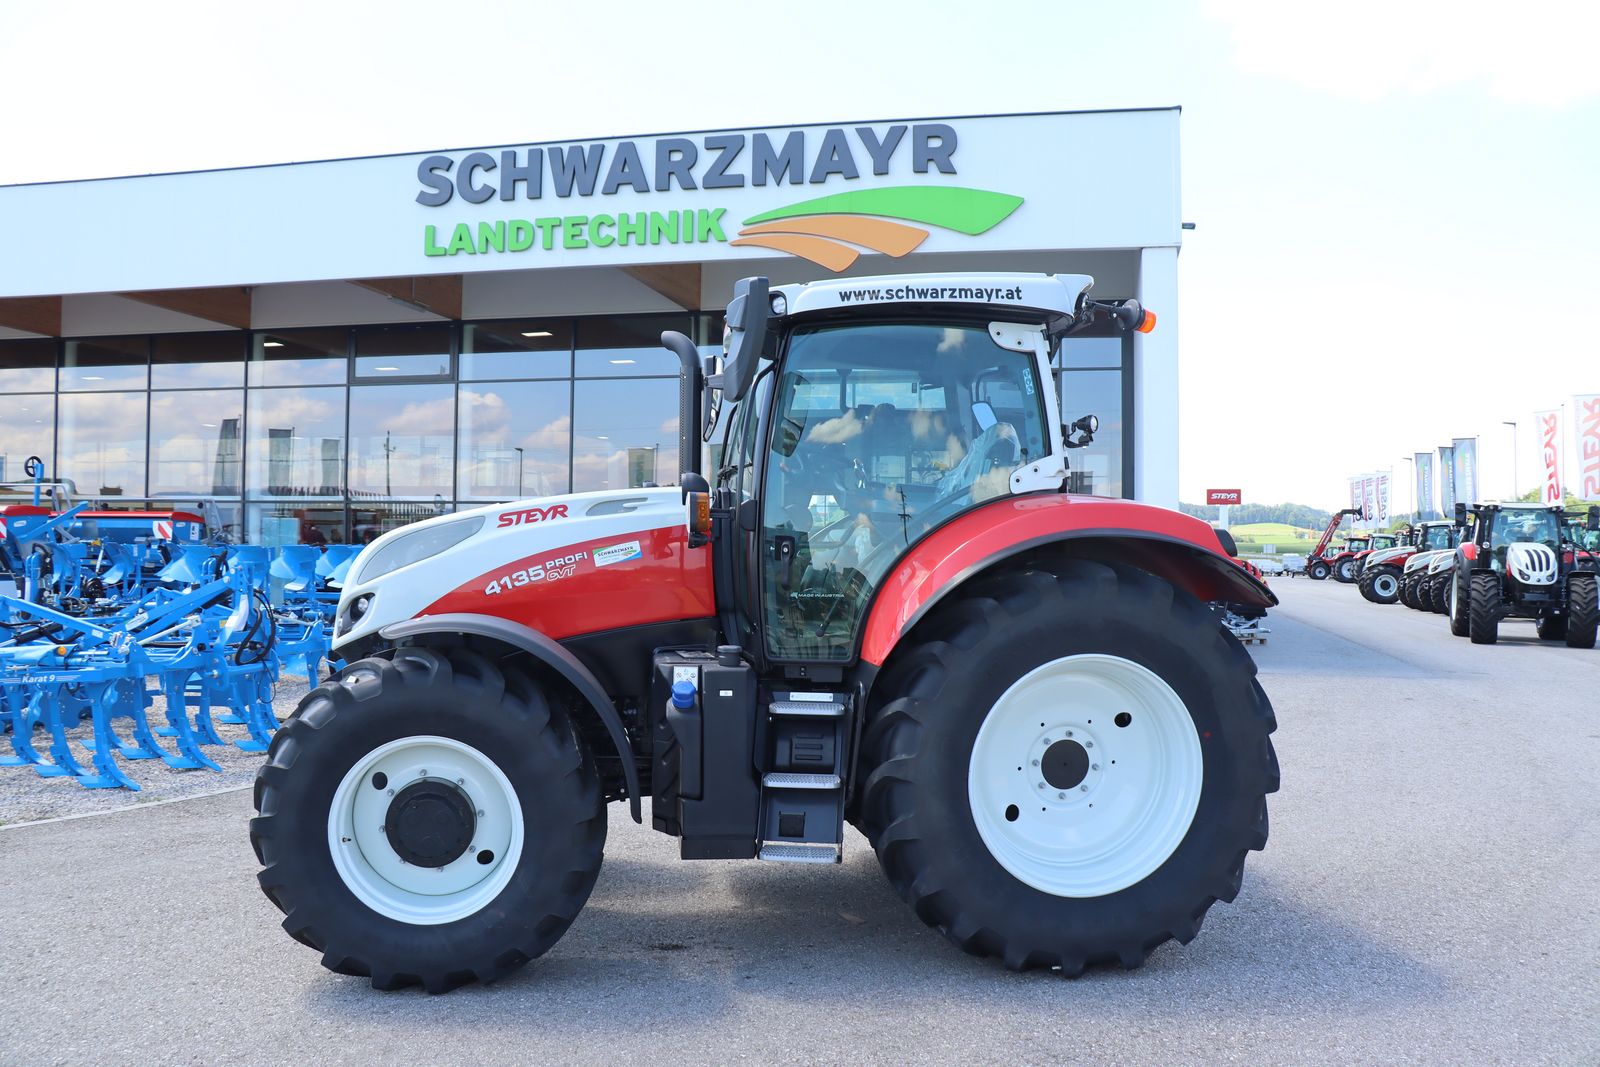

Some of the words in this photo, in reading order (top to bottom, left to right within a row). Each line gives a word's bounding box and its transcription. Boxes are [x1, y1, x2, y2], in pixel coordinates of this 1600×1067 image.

[415, 123, 958, 207] SCHWARZMAYR
[424, 207, 728, 256] LANDTECHNIK
[839, 285, 1022, 303] www.schwarzmayr.at
[497, 504, 569, 529] STEYR
[485, 565, 546, 596] 4135
[545, 551, 588, 570] PROFI
[546, 564, 576, 582] CVT
[22, 675, 48, 683] Karat
[49, 674, 56, 682] 9
